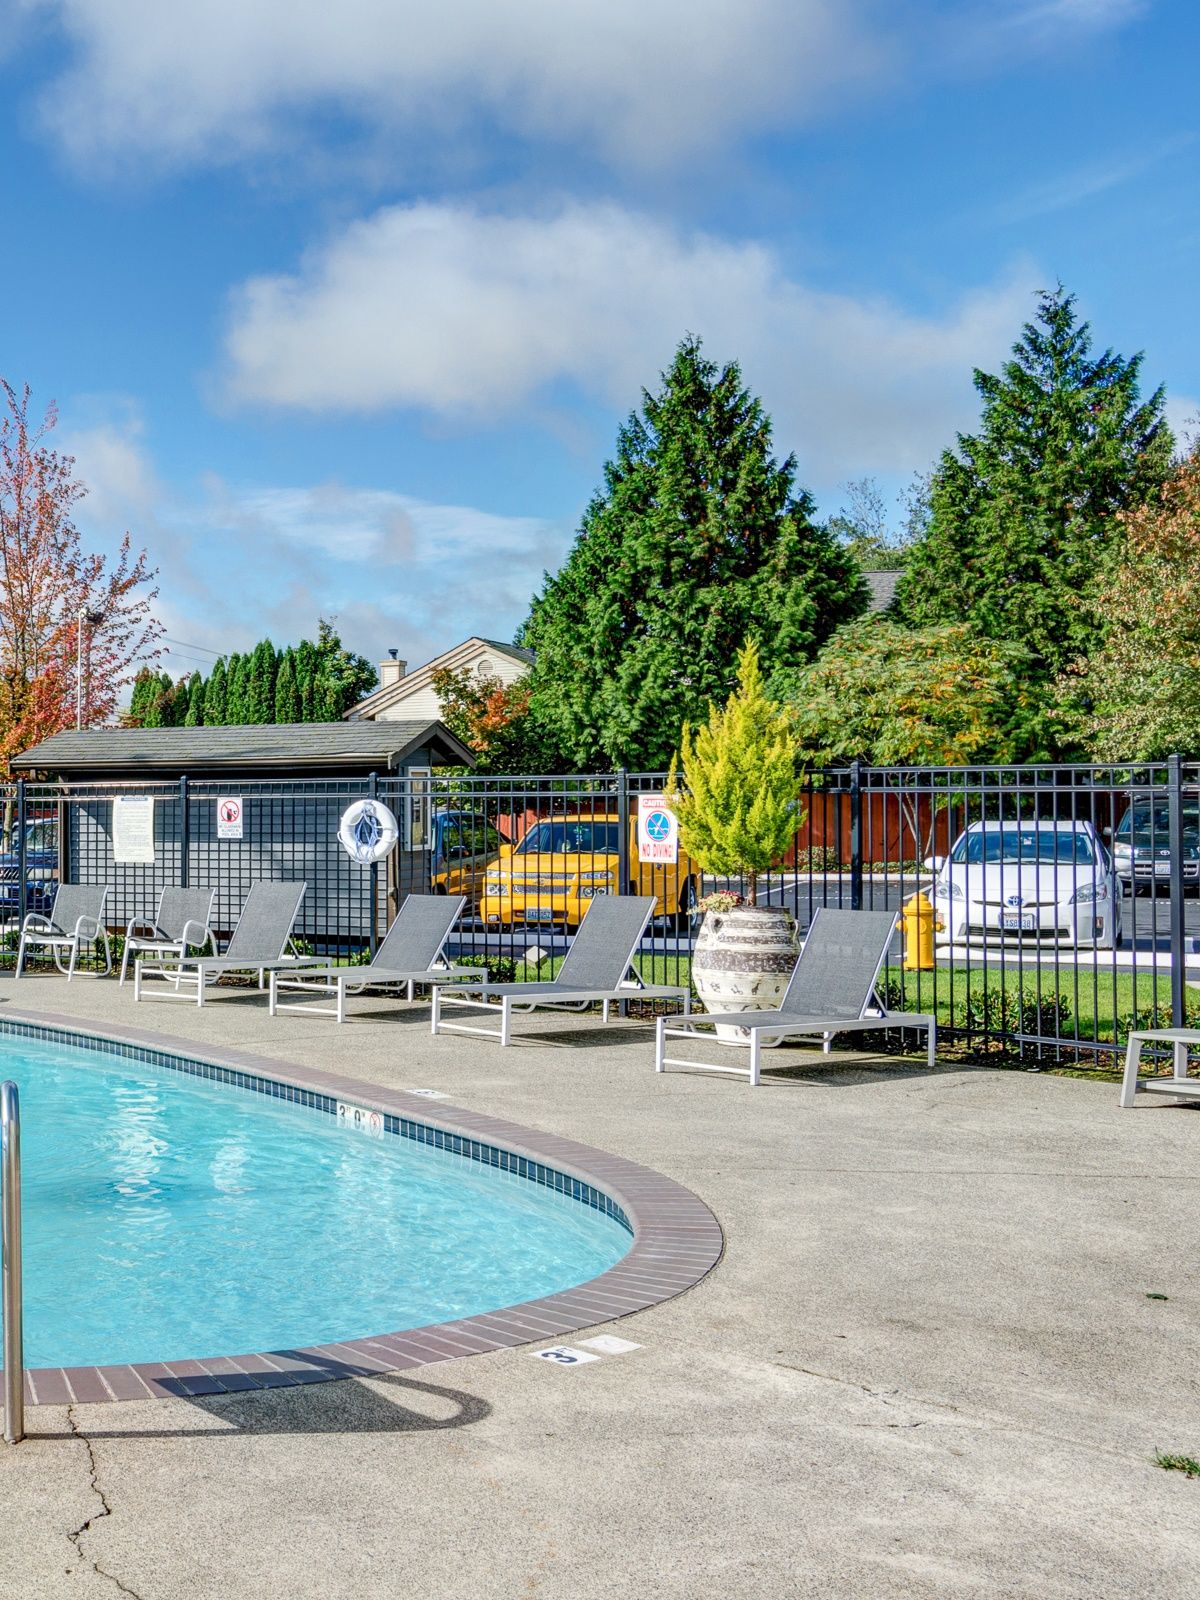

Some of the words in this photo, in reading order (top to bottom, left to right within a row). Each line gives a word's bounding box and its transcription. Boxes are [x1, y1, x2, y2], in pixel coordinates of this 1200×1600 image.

[642, 844, 650, 858] NO
[653, 844, 674, 858] DIVING!
[541, 1352, 578, 1363] 3
